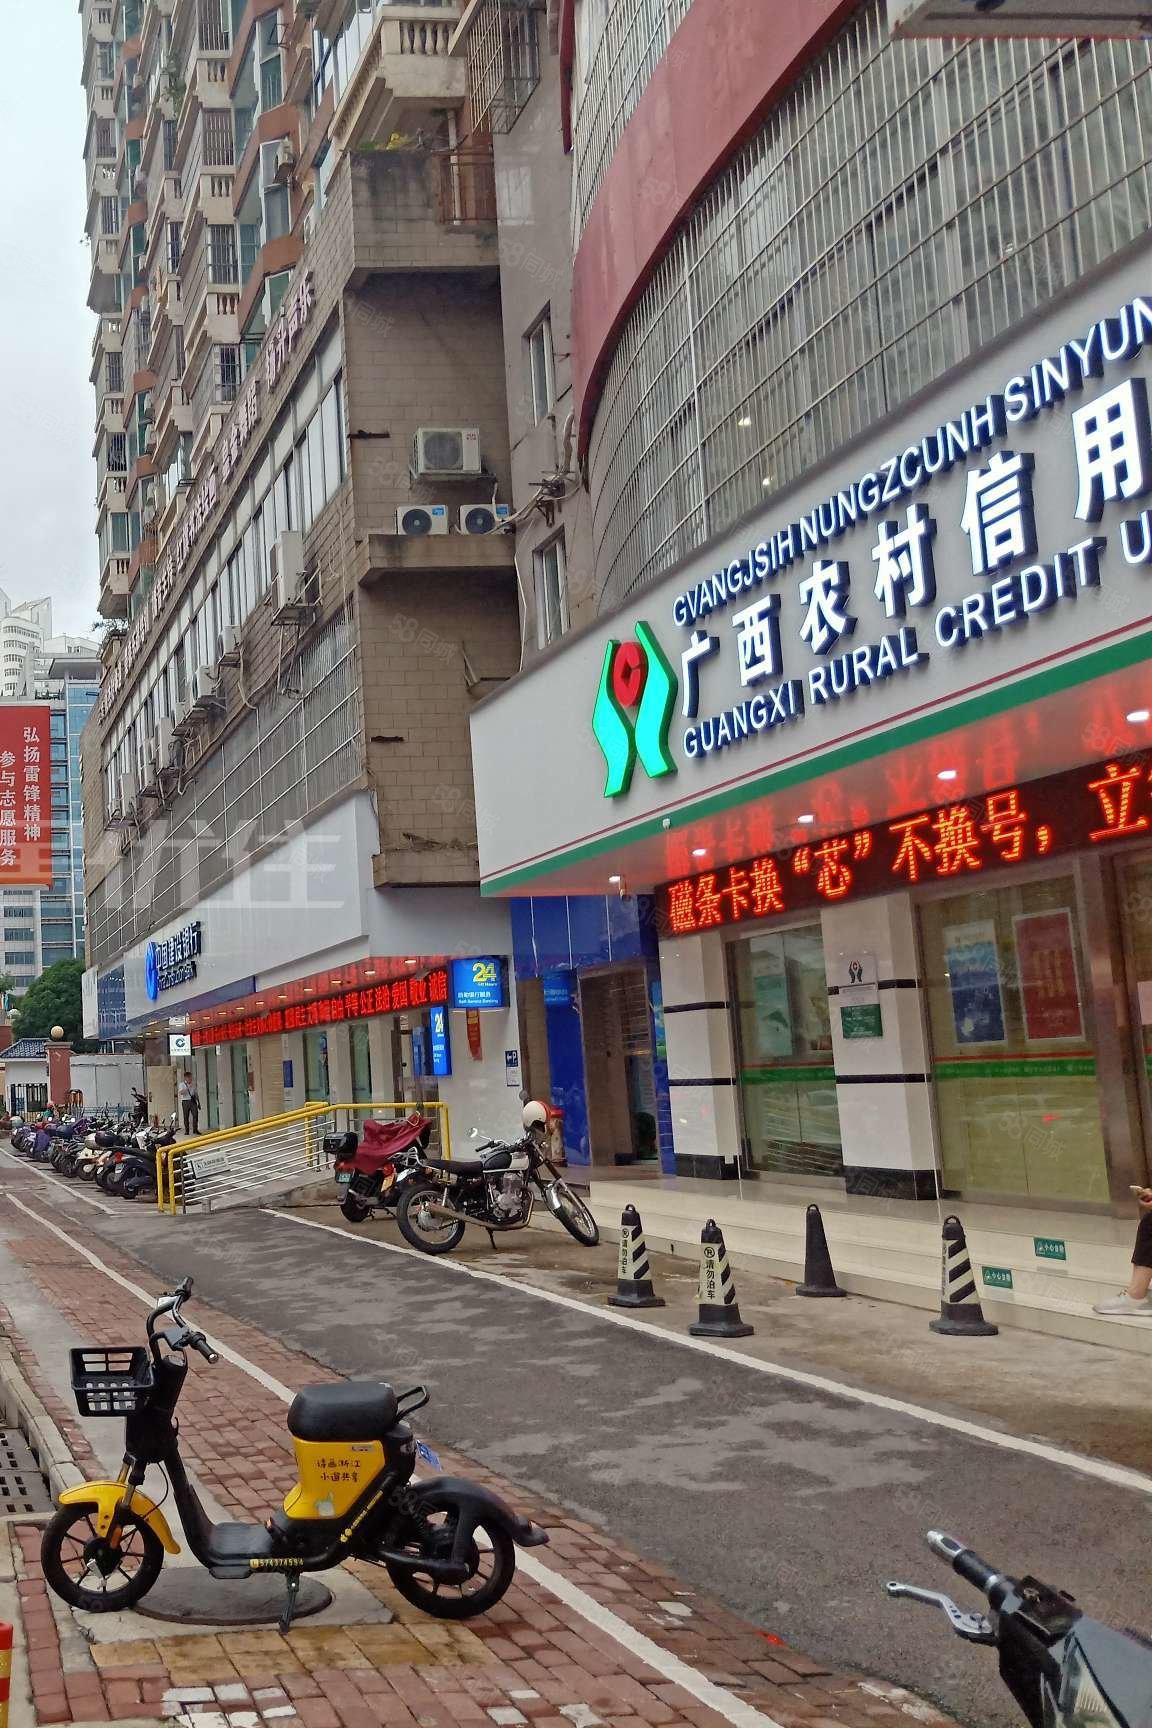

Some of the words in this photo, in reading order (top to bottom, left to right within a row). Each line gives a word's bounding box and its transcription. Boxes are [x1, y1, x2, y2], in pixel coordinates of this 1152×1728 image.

[673, 523, 798, 626] GVANGJSIH
[799, 396, 1000, 550] NUNGZCUNH
[681, 378, 1149, 718] 广西农村信用
[683, 680, 800, 757] GUANGXI
[808, 628, 924, 705] RURAL
[935, 536, 1100, 647] CREDIT
[22, 726, 41, 842] 弘扬雷锋精神
[156, 923, 199, 970] 中国建设银行
[472, 962, 497, 982] 24
[620, 1240, 629, 1274] 请勿泊车
[705, 1259, 716, 1299] 请勿泊车
